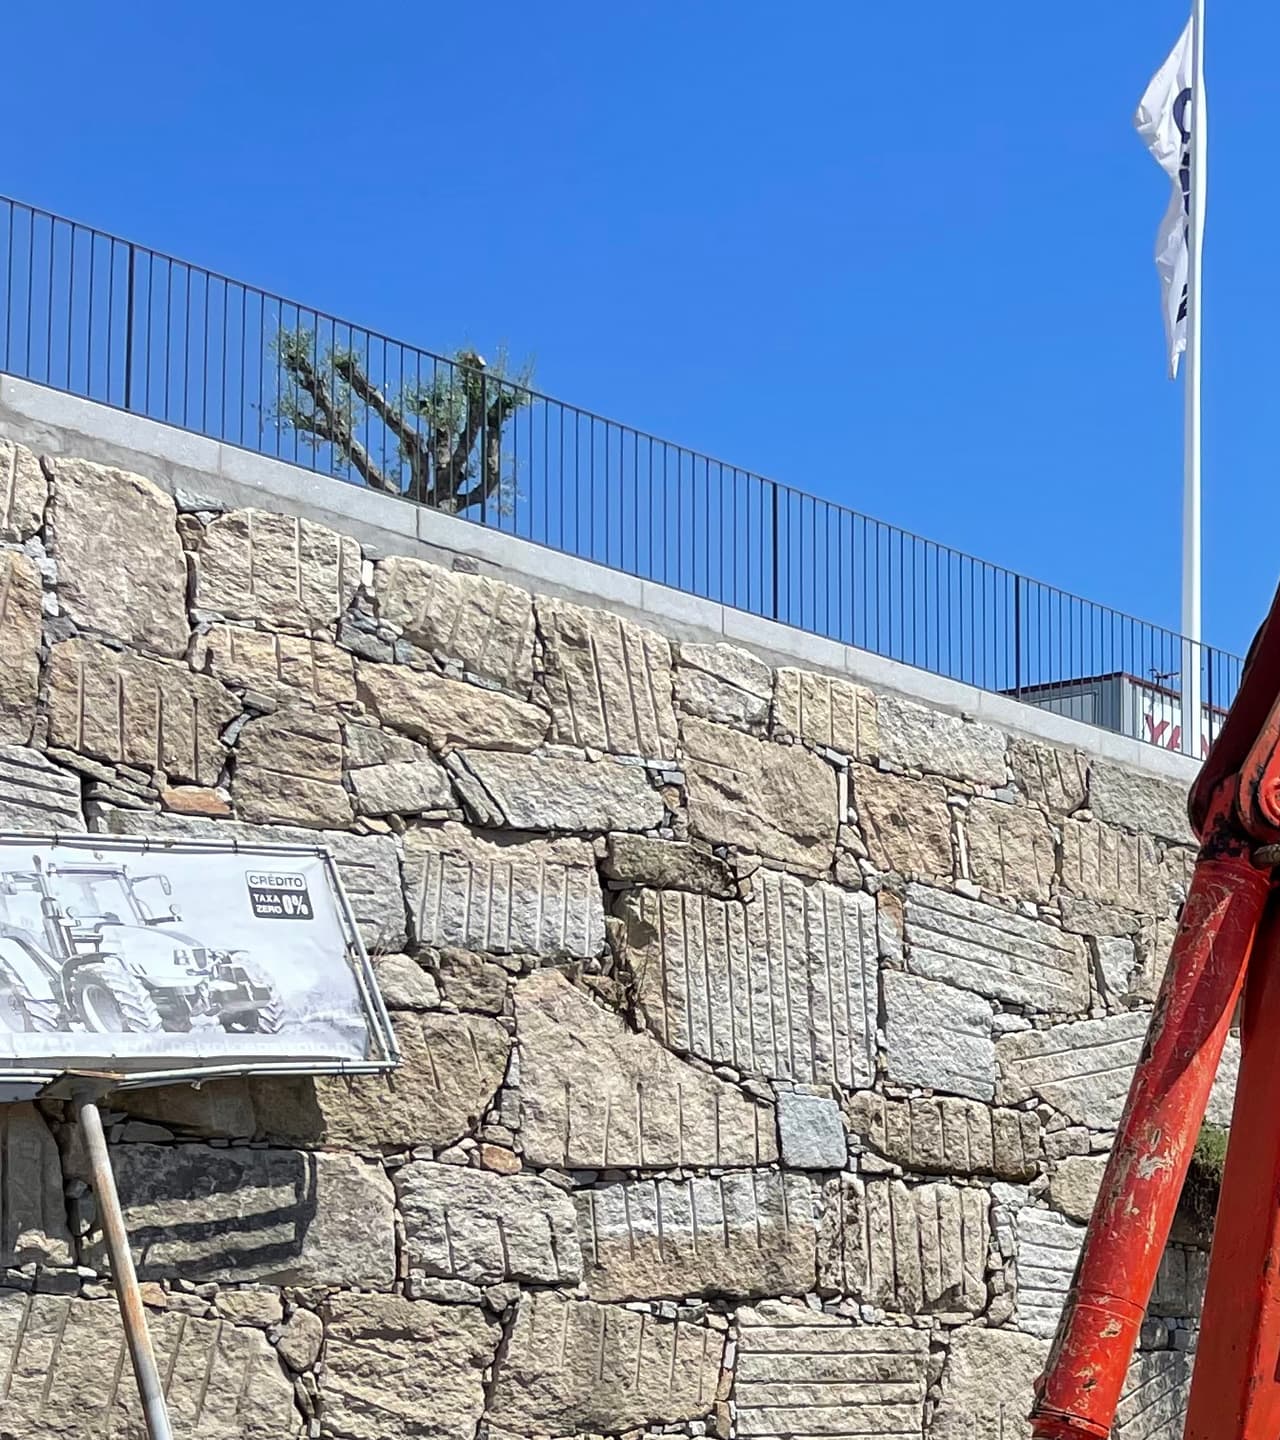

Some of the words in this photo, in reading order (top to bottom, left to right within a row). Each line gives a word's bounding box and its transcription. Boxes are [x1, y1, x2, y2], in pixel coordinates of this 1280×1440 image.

[249, 873, 303, 888] CRÉDITO
[253, 893, 281, 903] TAXA
[281, 894, 309, 915] 0%
[256, 904, 283, 914] ZERO
